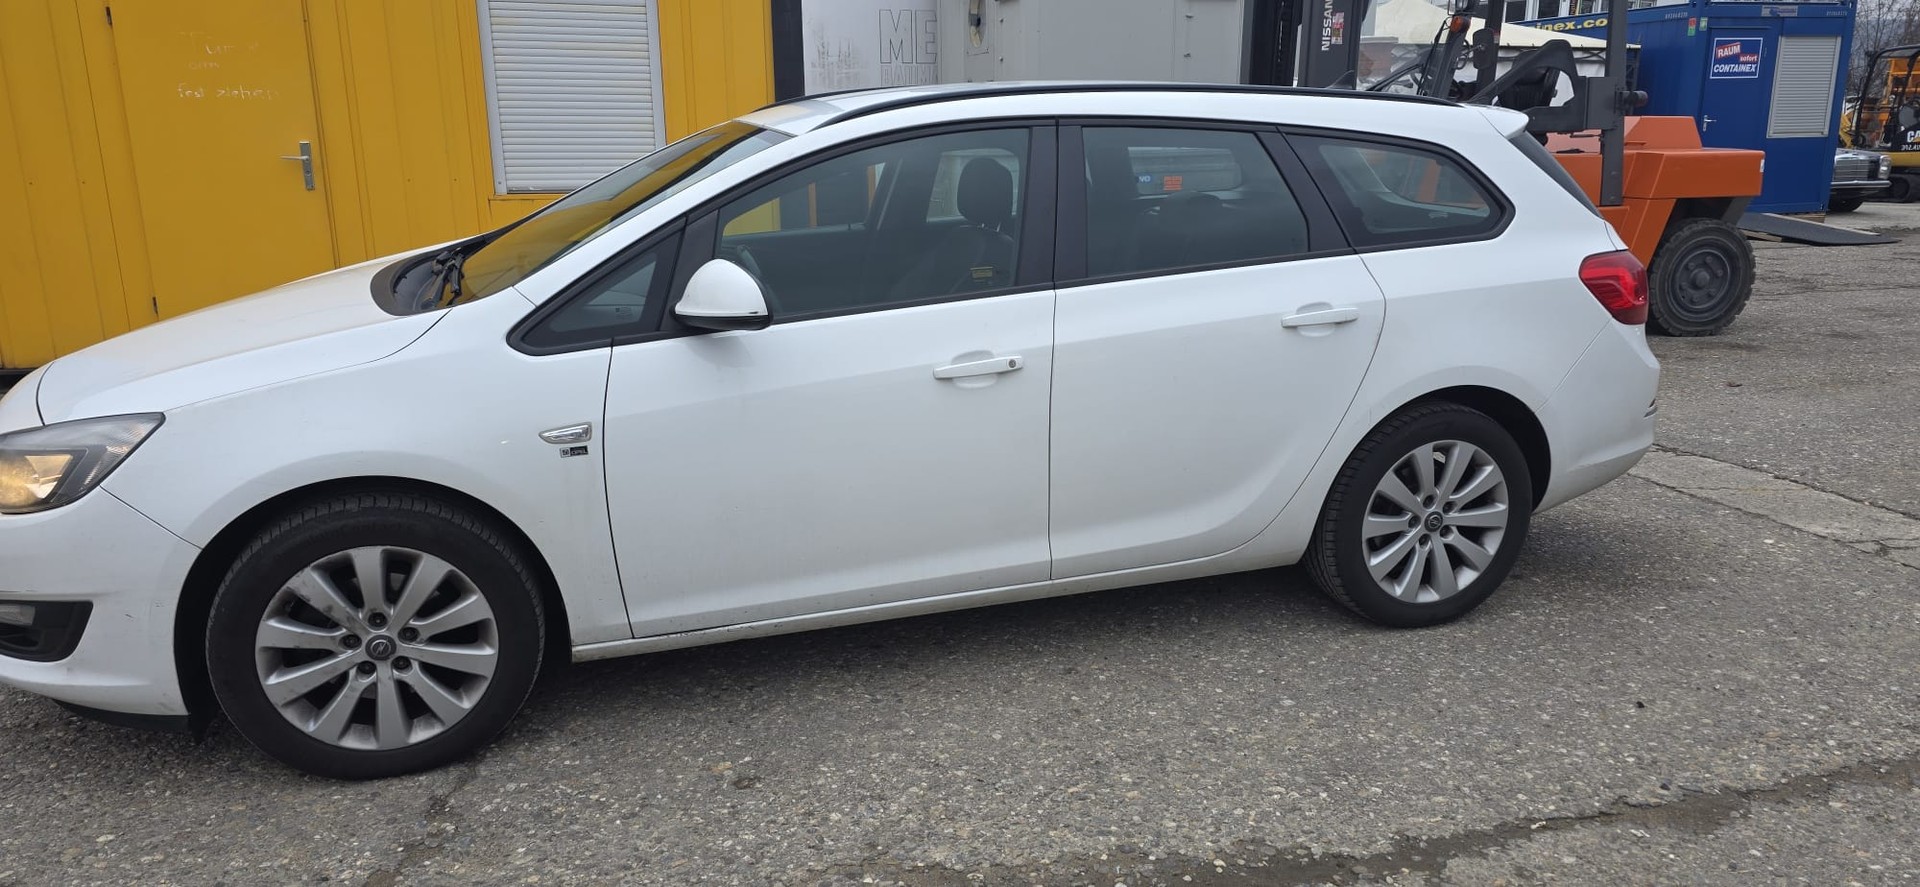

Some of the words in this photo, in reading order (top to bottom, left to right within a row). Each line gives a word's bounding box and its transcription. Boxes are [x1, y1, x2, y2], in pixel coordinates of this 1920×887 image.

[1321, 0, 1333, 51] NISSAN
[1717, 44, 1741, 59] RAUM
[1739, 54, 1758, 62] sofort
[1713, 64, 1757, 73] CONTAINEX
